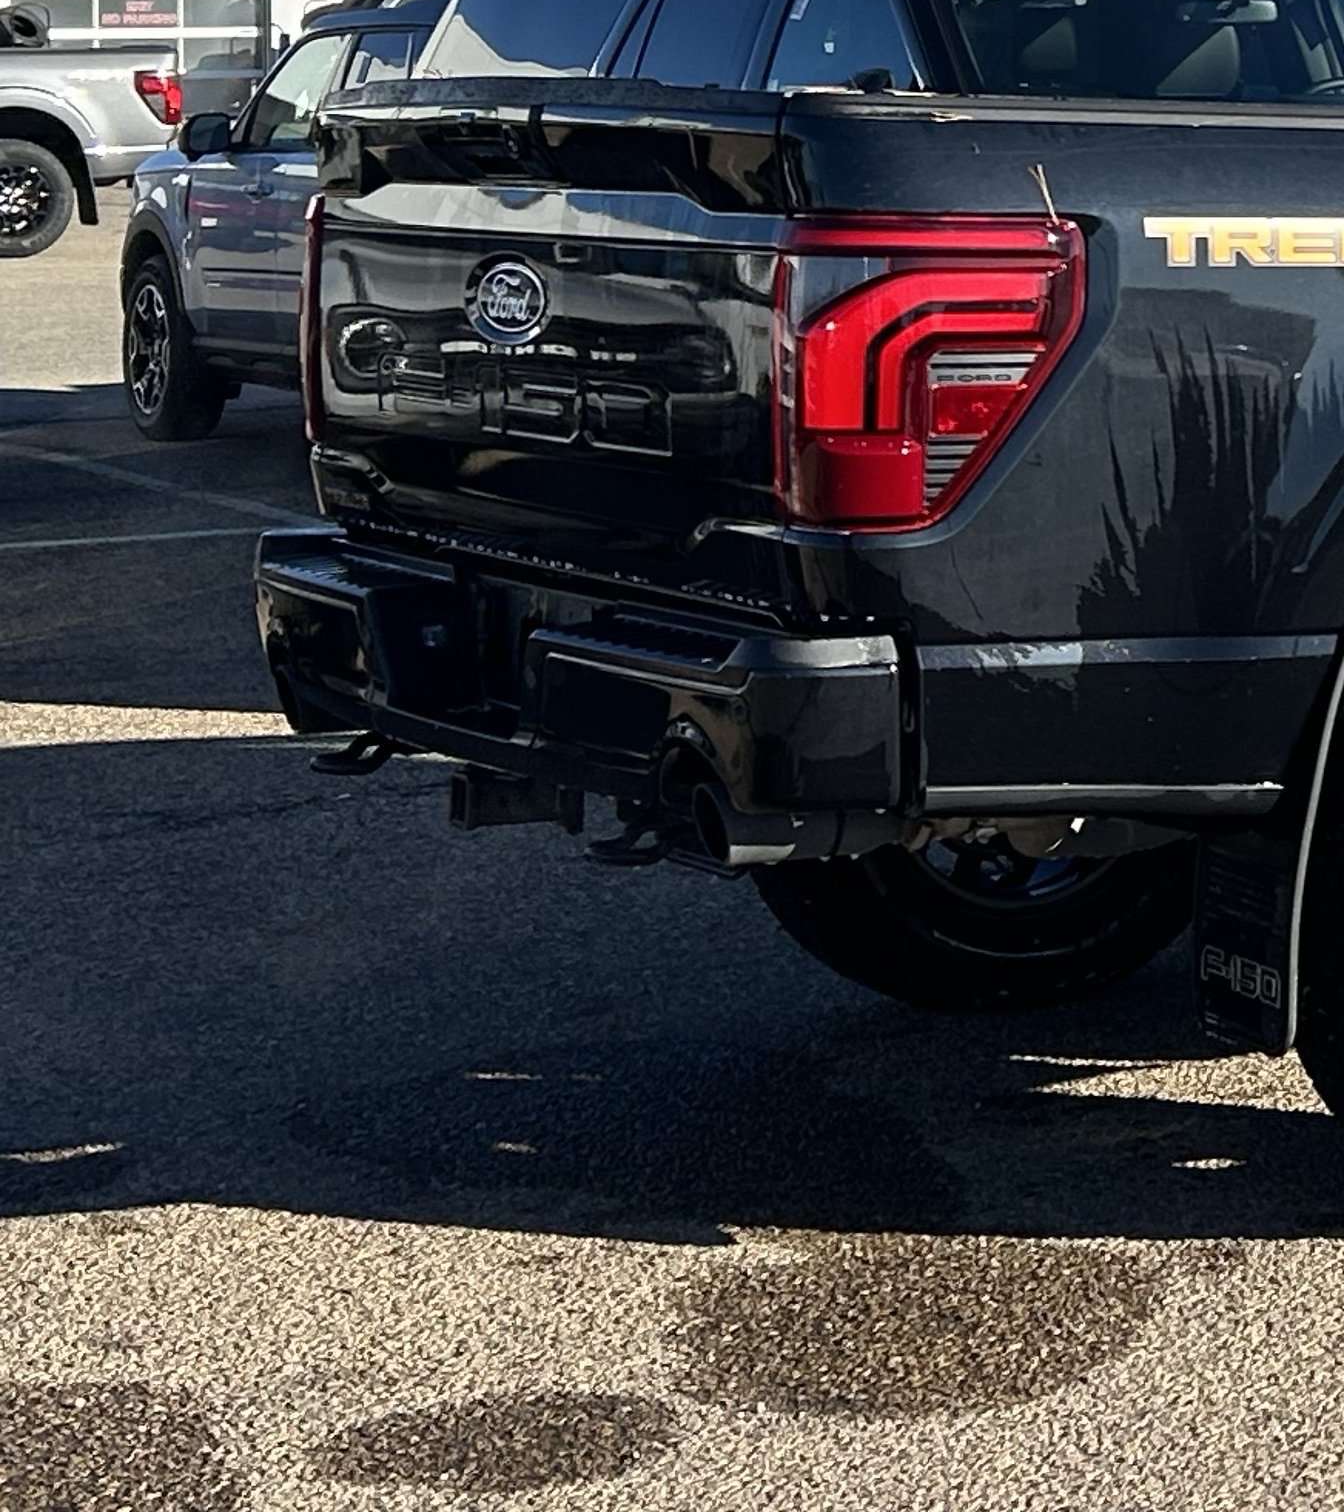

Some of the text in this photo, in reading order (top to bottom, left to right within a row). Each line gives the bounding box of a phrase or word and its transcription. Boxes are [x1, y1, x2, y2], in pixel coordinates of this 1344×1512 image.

[486, 274, 532, 321] Ford
[379, 351, 672, 457] F-150
[937, 374, 1012, 382] FORD
[1200, 944, 1281, 1009] F-150
